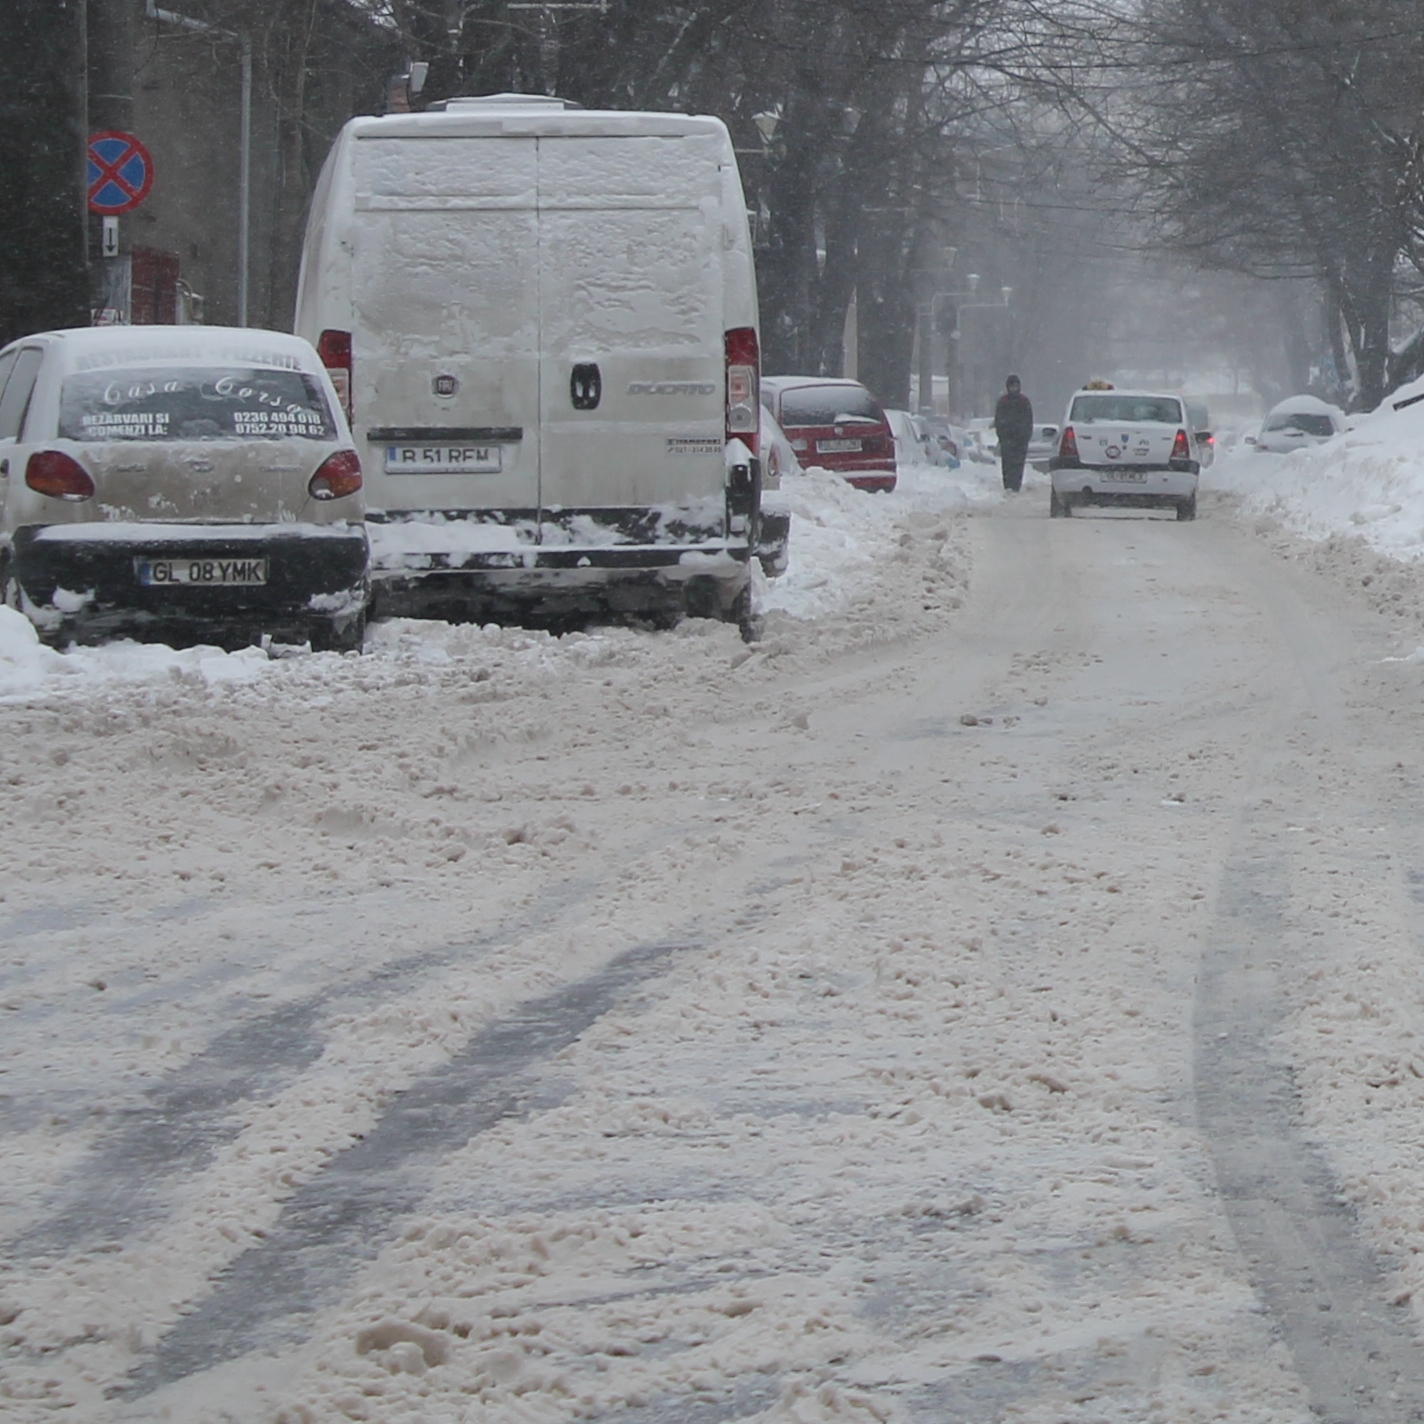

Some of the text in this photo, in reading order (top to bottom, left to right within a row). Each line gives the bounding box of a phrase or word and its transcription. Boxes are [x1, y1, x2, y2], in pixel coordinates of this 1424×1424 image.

[104, 376, 301, 413] Casa Corso
[155, 413, 170, 424] SI
[234, 412, 268, 423] 0236
[271, 412, 296, 423] 494
[153, 561, 262, 582] GL 08 YMK
